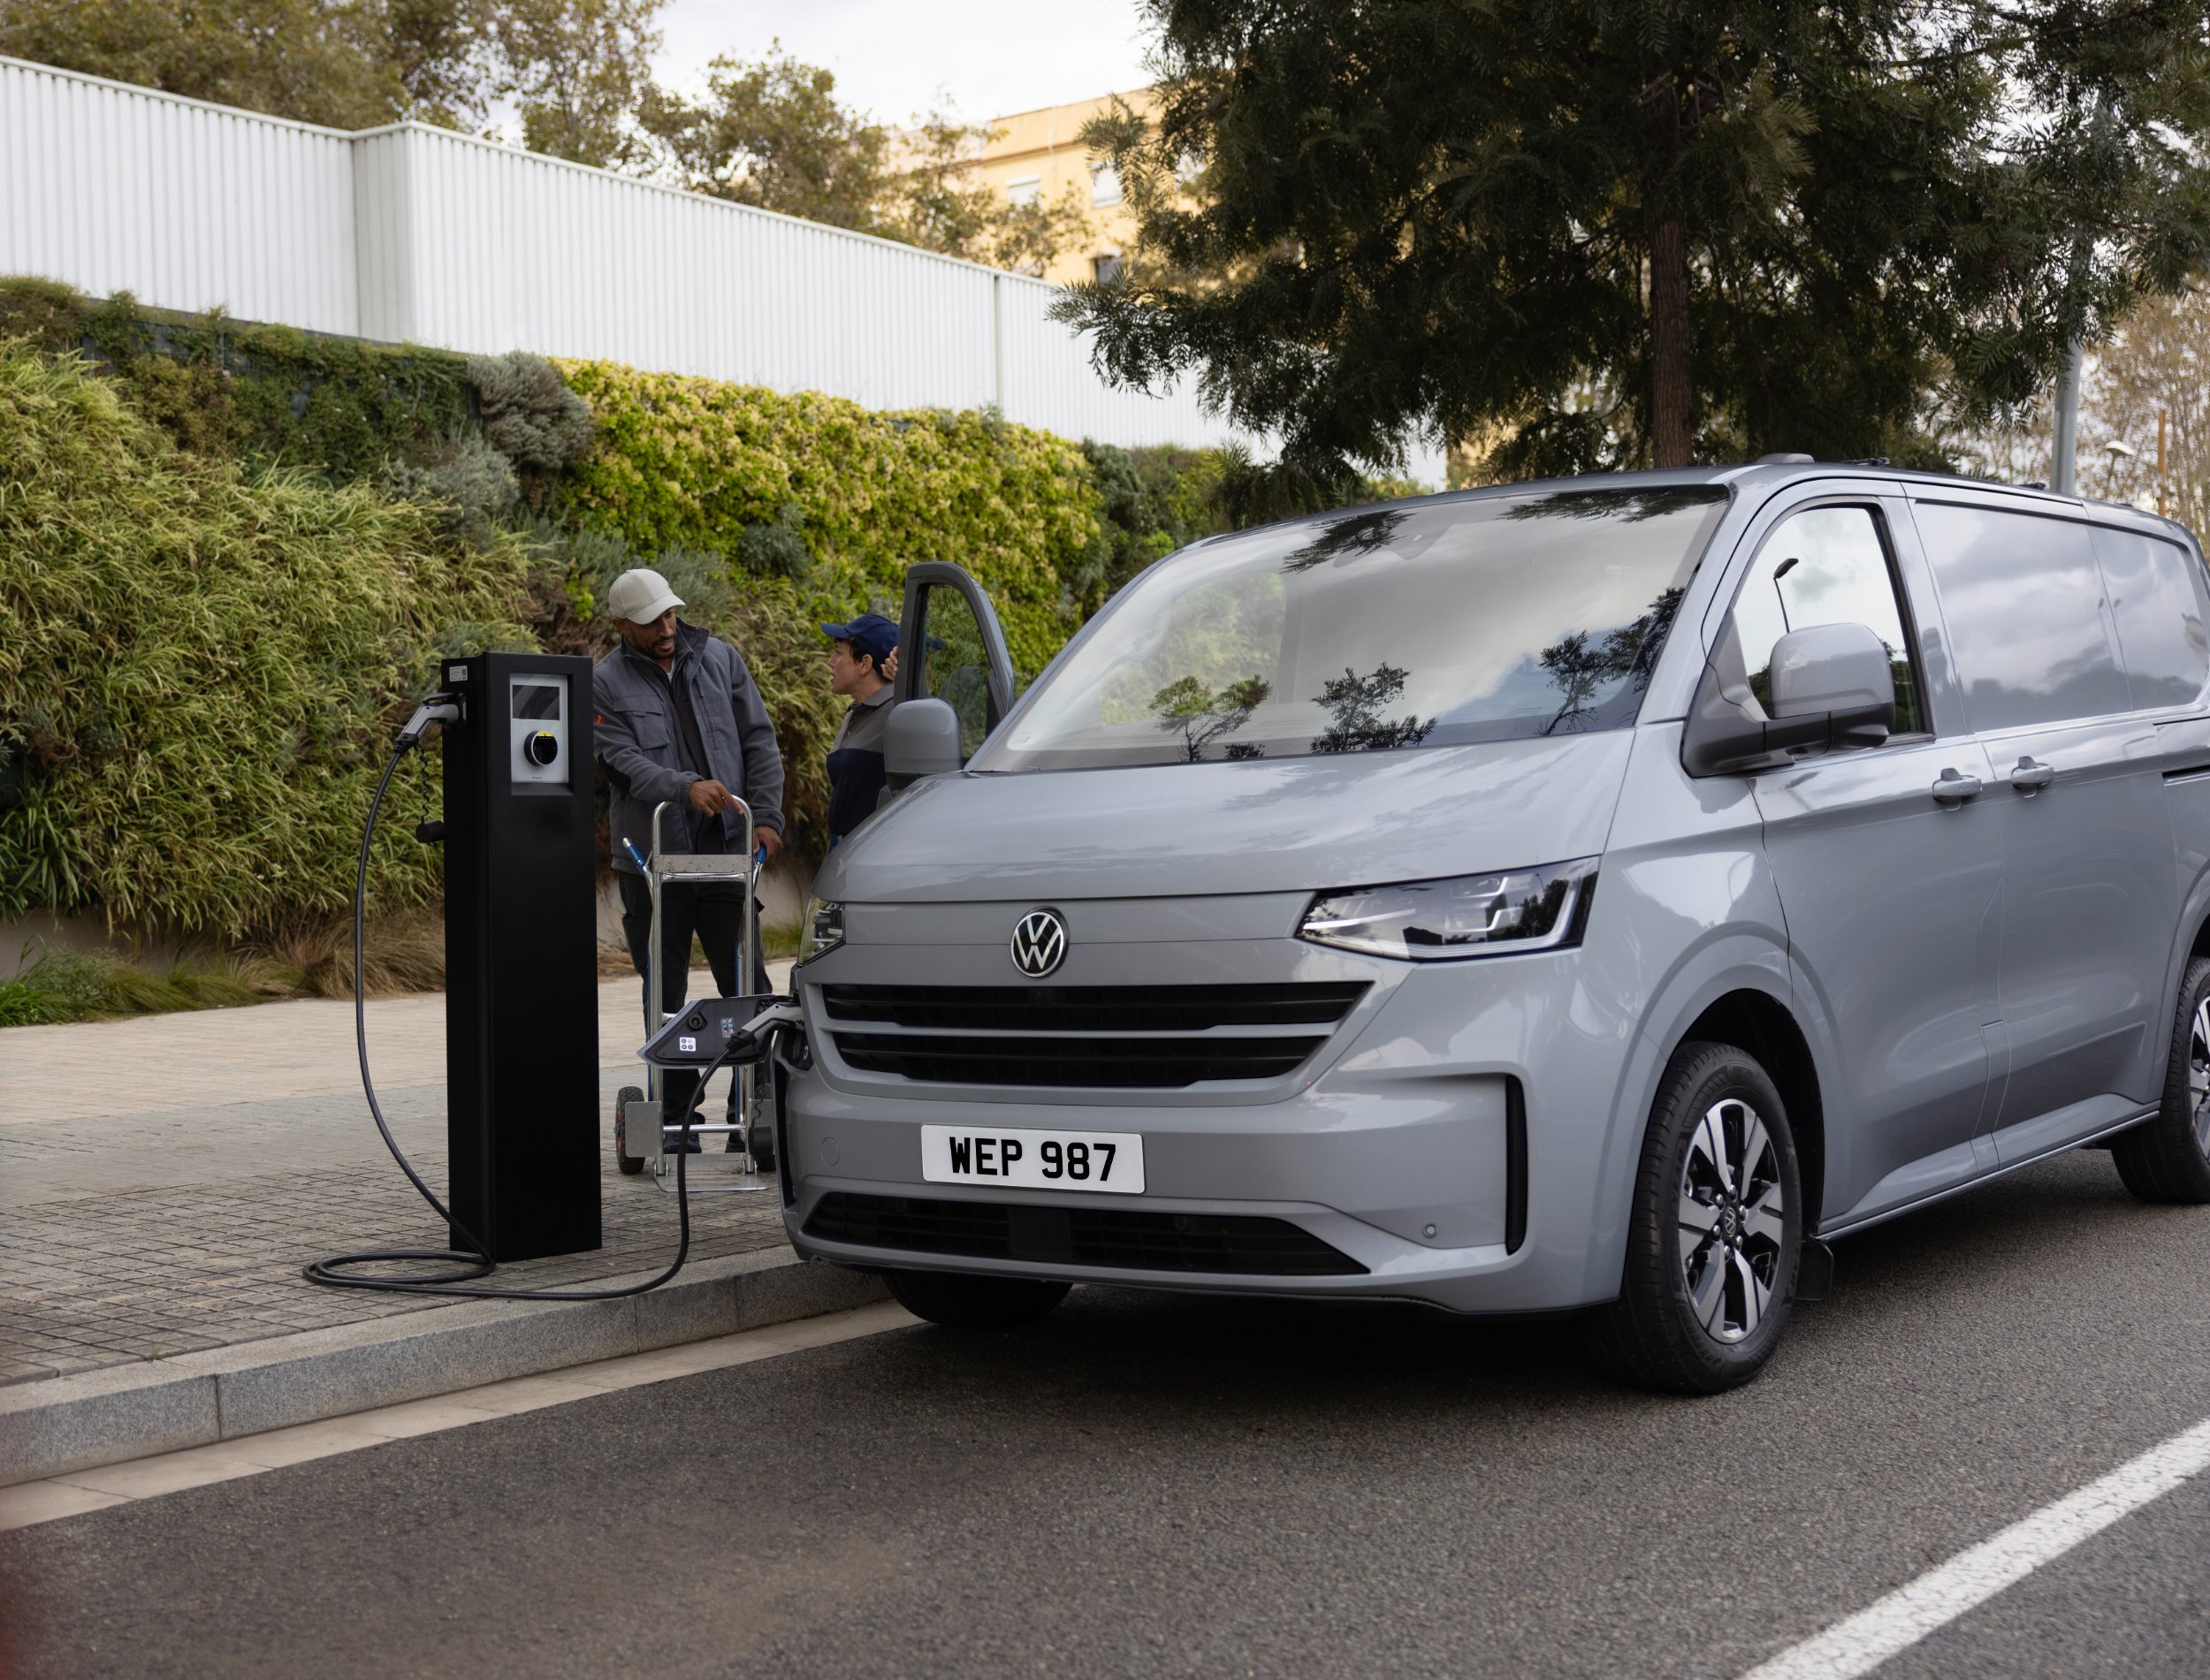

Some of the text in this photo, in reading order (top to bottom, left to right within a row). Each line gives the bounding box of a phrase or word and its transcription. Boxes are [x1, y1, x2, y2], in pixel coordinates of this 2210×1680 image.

[1011, 911, 1064, 977] VW
[949, 1136, 1116, 1182] WEP 987
